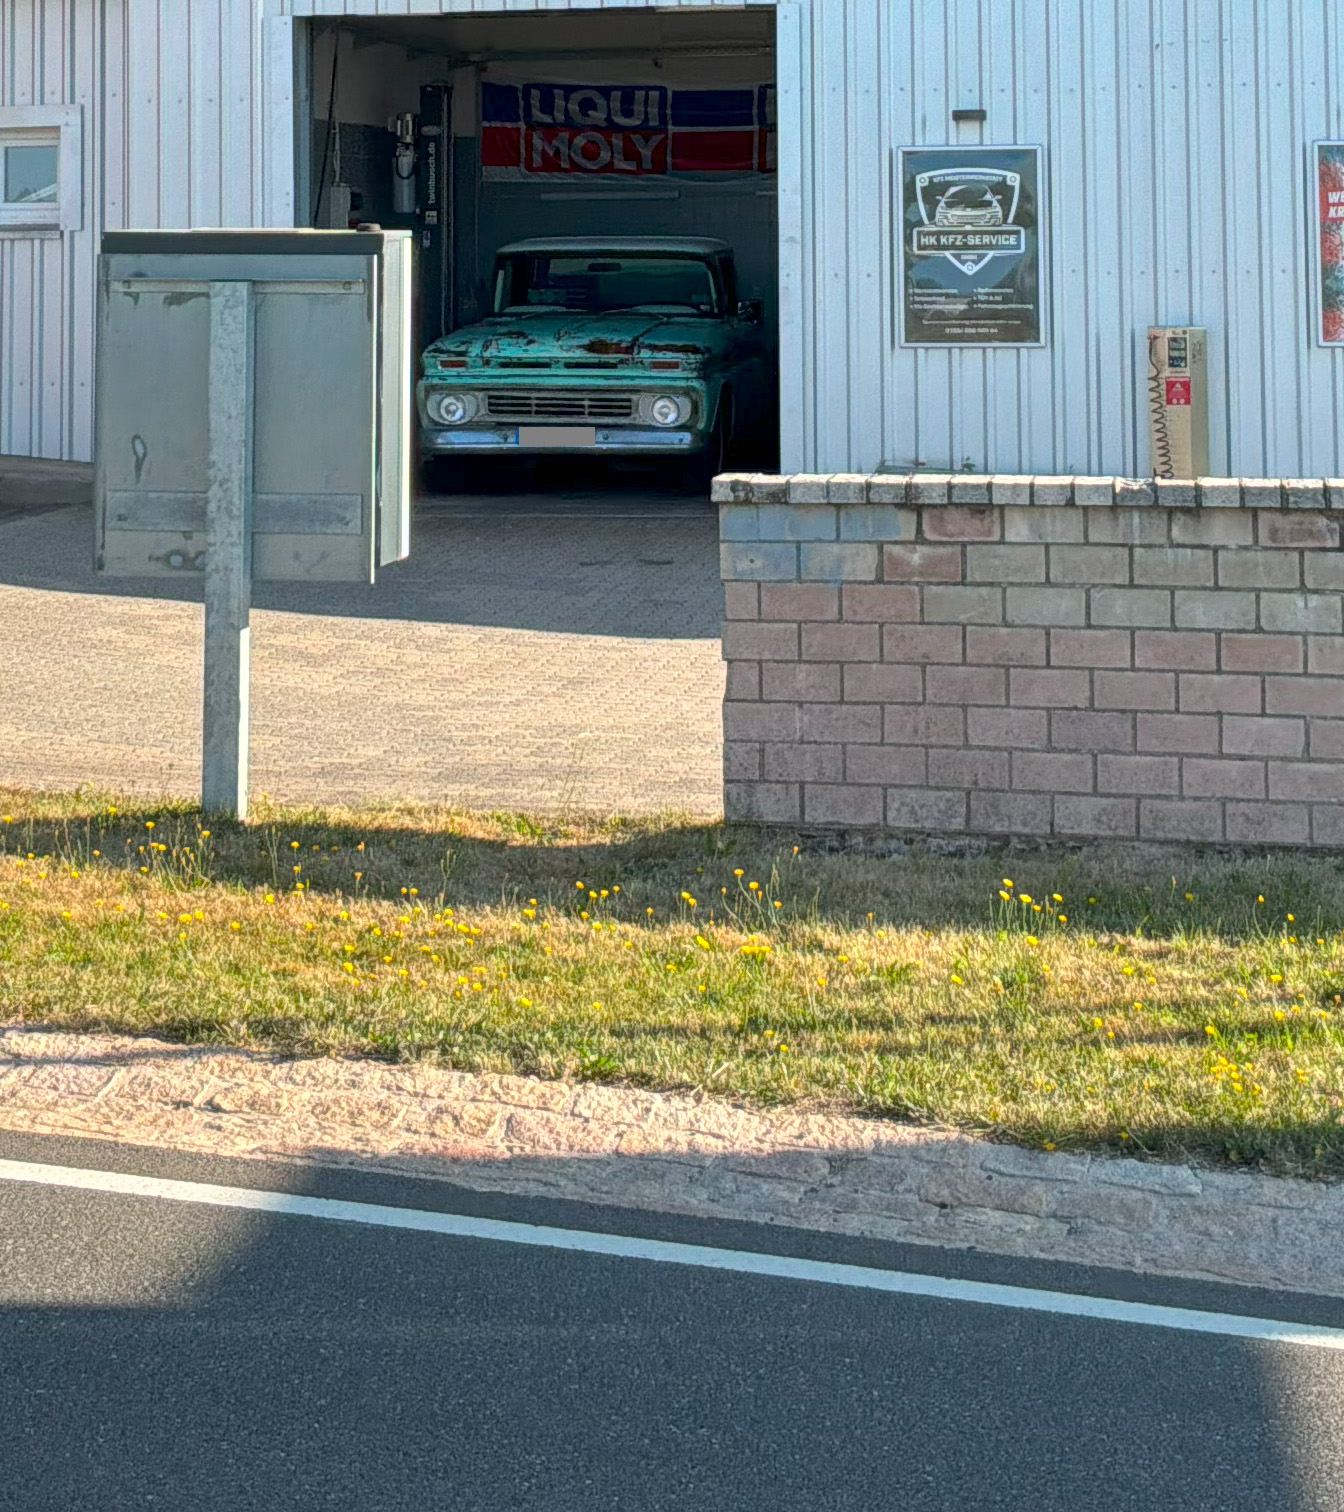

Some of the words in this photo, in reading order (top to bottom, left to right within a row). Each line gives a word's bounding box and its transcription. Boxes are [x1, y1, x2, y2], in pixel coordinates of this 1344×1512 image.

[529, 88, 661, 127] LIQUI
[531, 130, 666, 171] MOLY
[921, 235, 938, 246] HK
[940, 235, 1018, 246] KFZ-SERVICE
